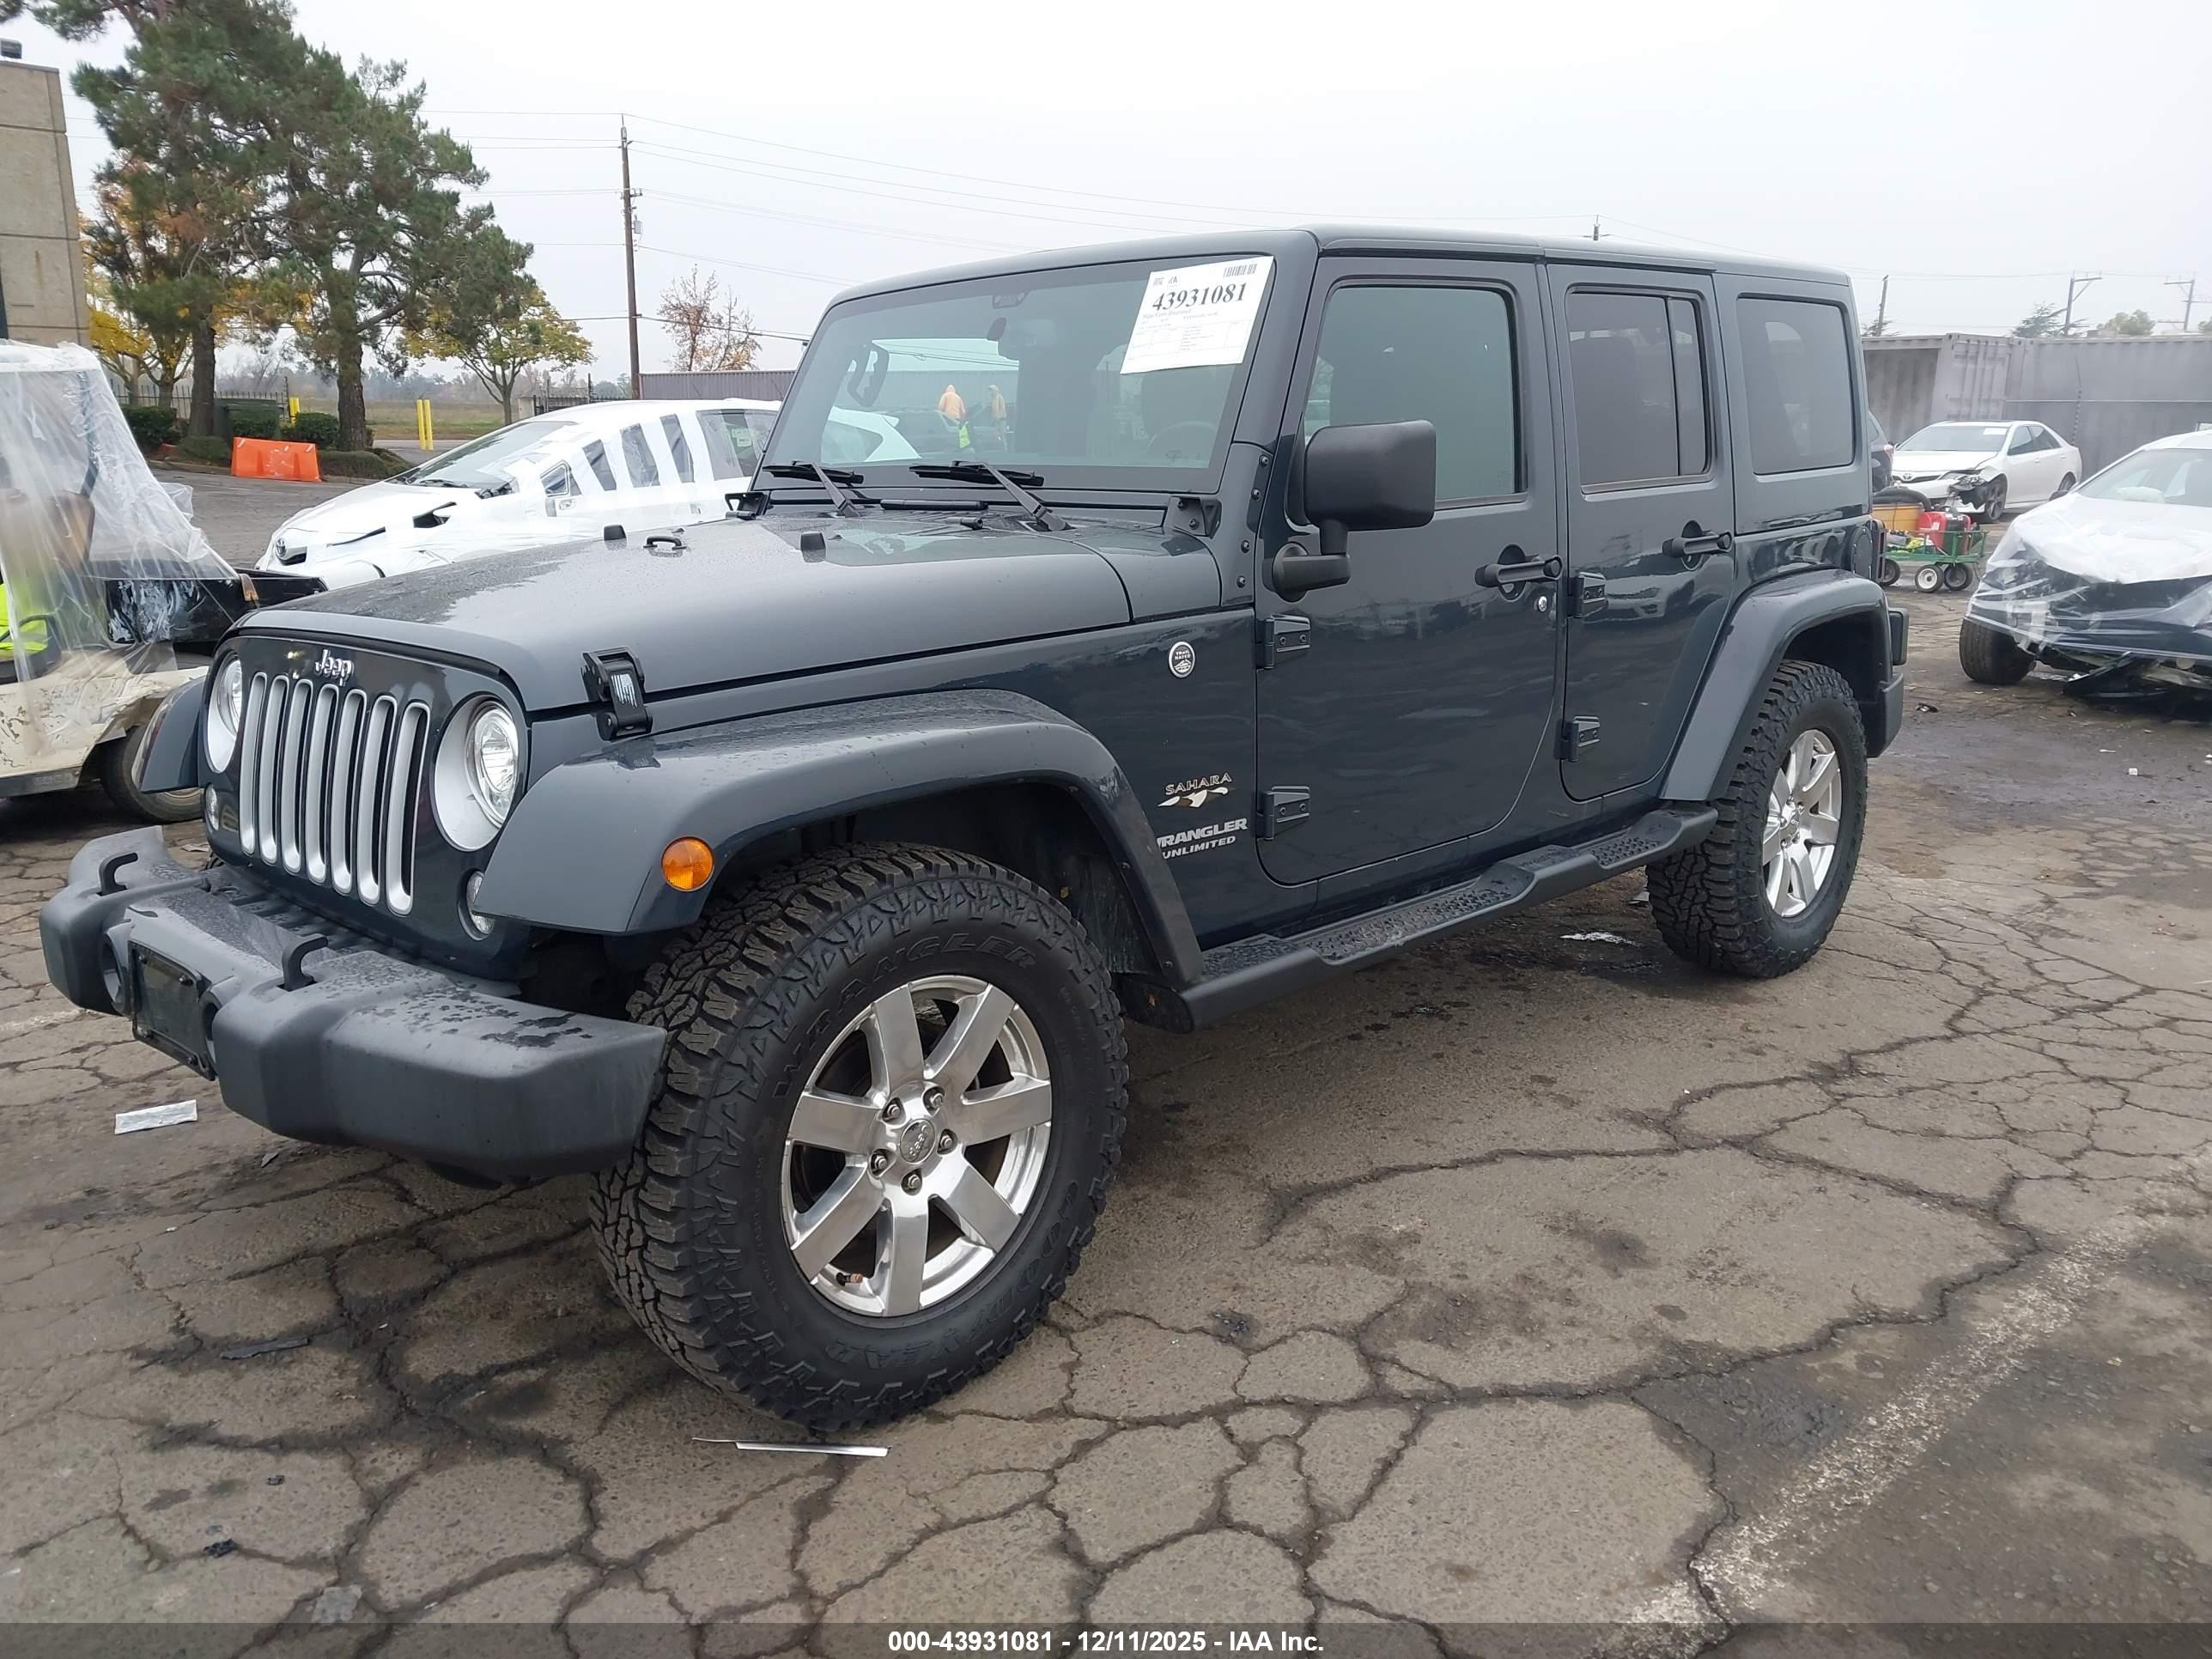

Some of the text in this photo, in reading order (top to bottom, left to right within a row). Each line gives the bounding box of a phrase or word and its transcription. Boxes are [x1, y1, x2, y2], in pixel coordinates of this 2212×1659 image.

[1152, 283, 1247, 311] 43931081
[314, 649, 353, 686] Jeep
[1165, 772, 1232, 795] SAHARA
[1162, 836, 1237, 860] UNLIMITED
